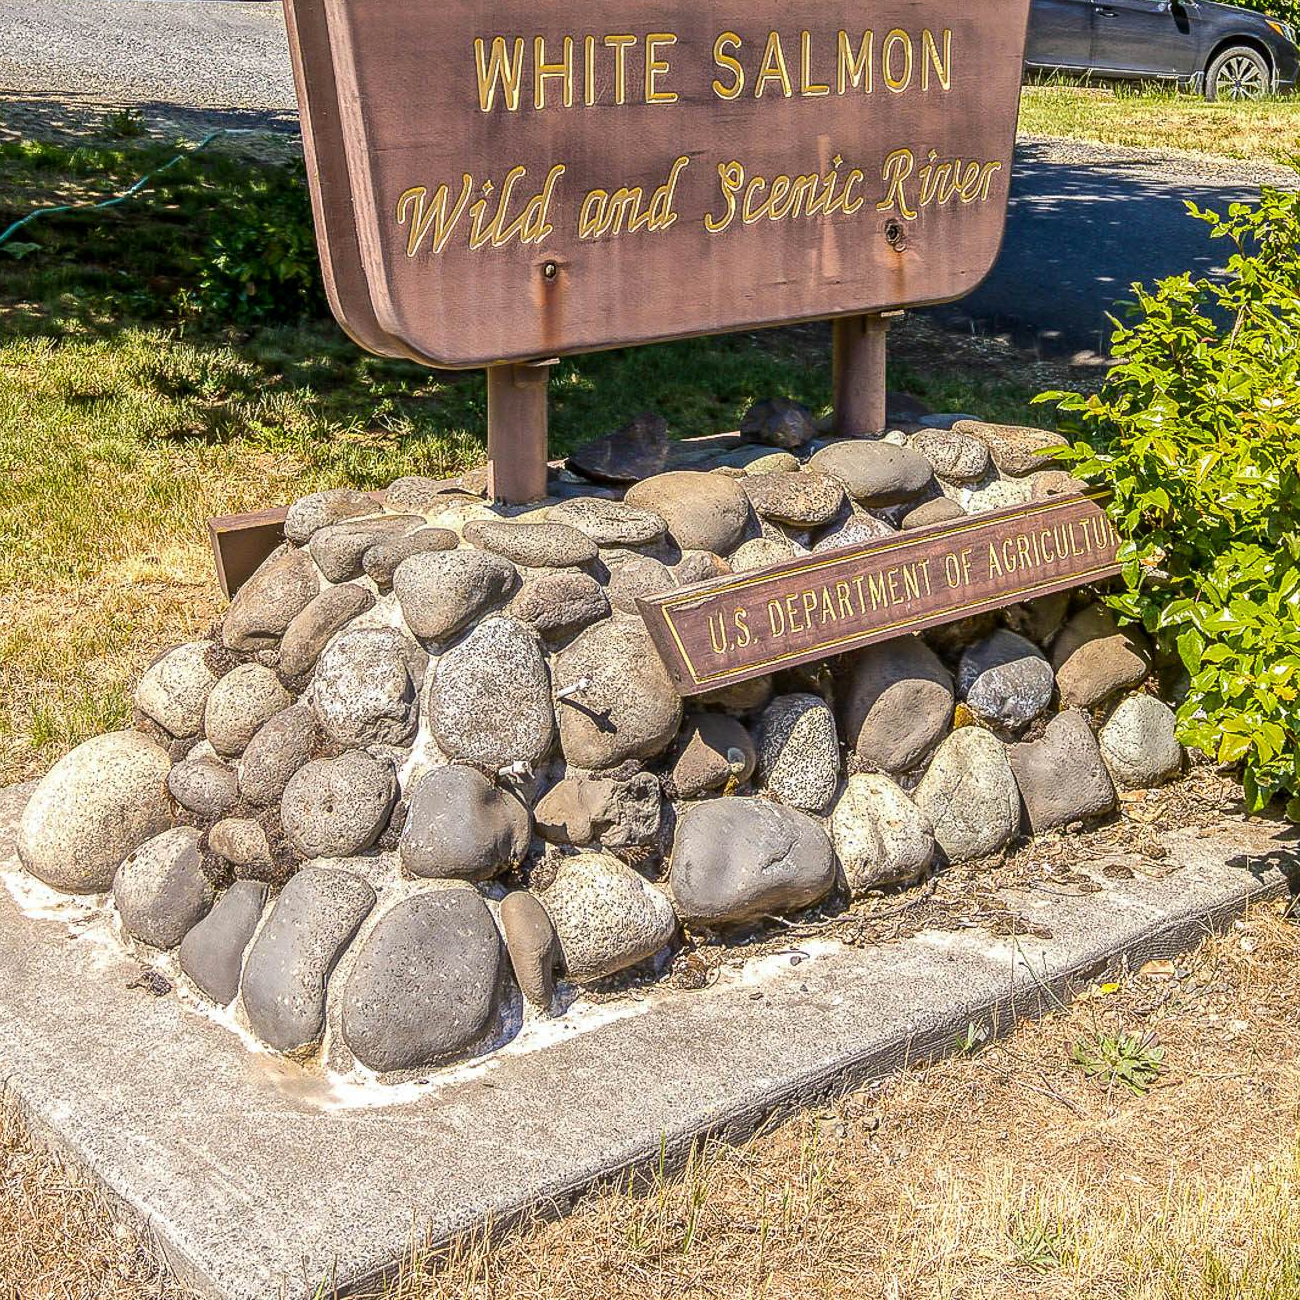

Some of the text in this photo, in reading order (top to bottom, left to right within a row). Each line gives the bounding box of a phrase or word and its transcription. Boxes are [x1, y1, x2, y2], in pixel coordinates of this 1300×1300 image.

[473, 28, 953, 112] WHITE SALMON
[397, 149, 1002, 258] Wild and Scenic River
[708, 514, 1123, 655] U.S. DEPARTMENT OF AGRICULTUR
